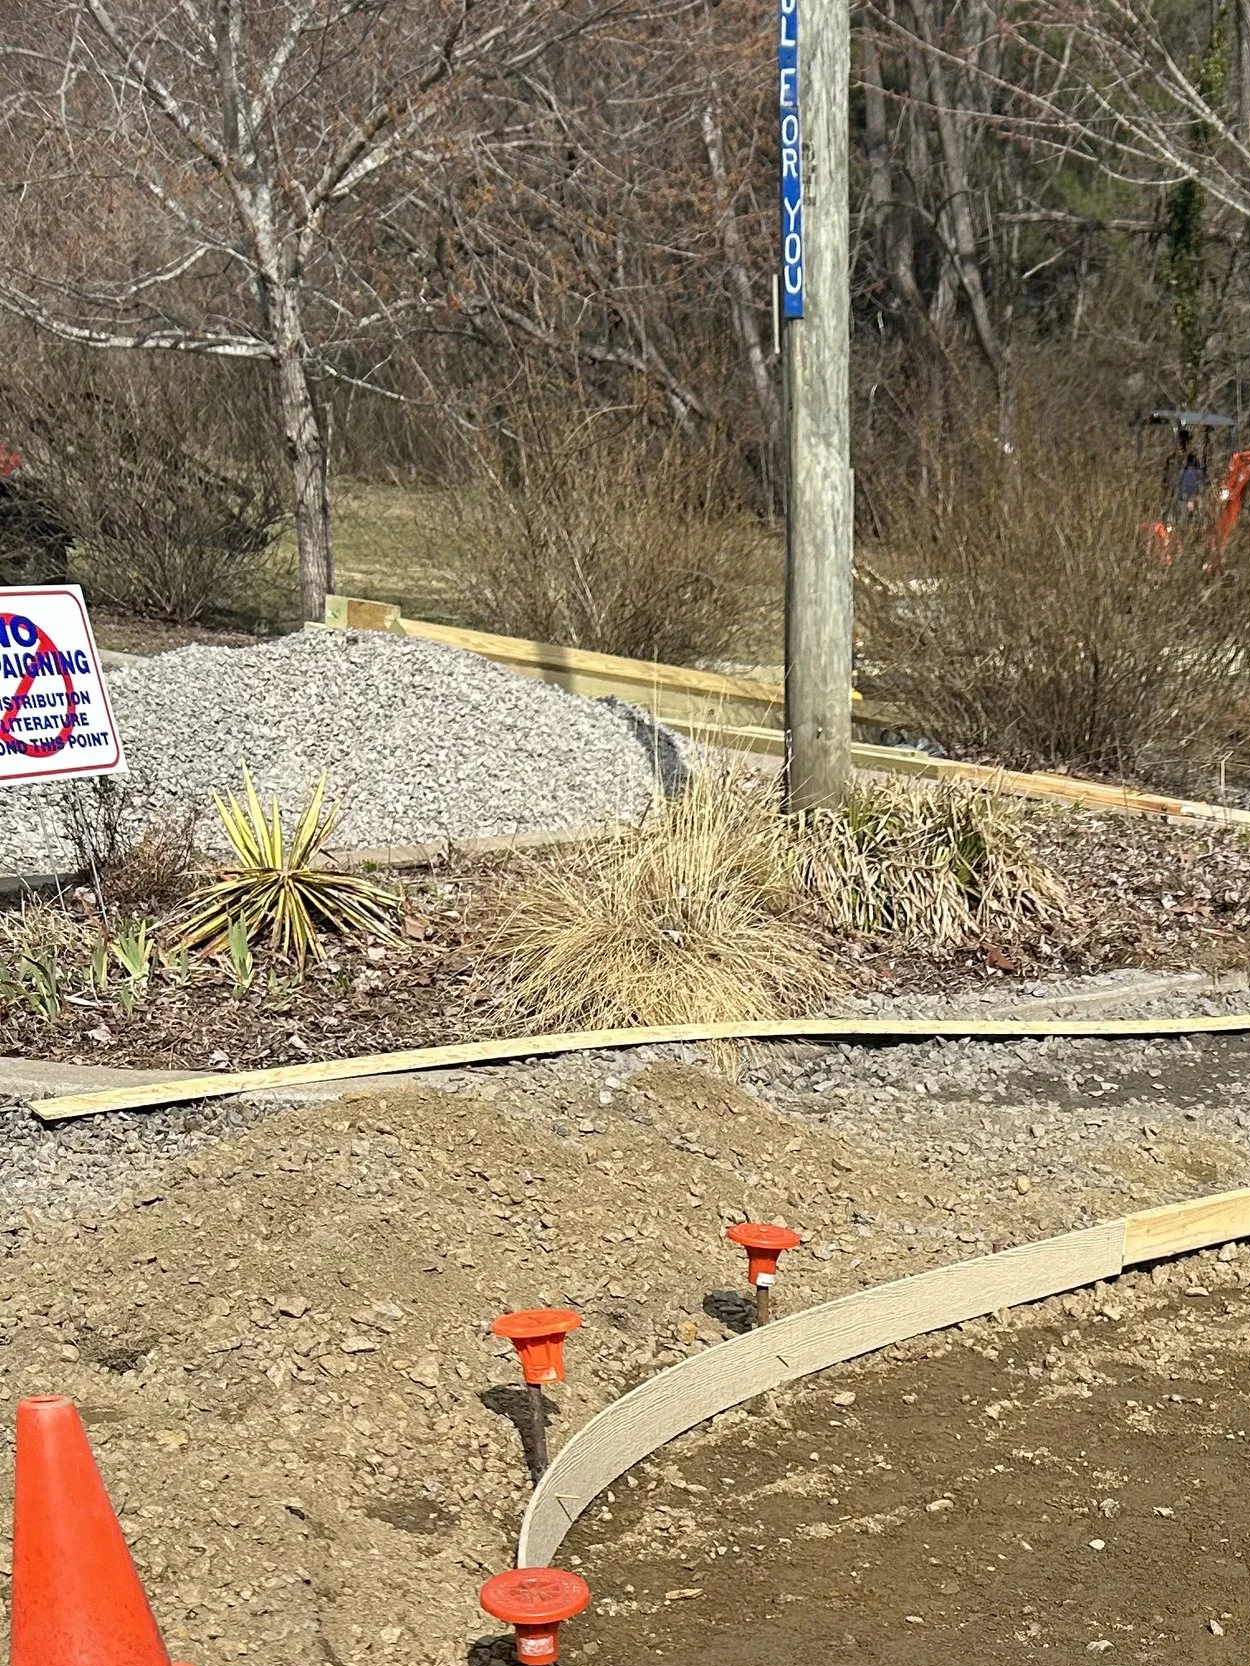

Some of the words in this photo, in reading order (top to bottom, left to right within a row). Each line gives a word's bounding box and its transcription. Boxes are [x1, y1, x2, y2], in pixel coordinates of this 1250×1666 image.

[784, 197, 802, 294] YOU
[0, 649, 91, 679] AIGNING
[29, 736, 65, 753] THIS
[67, 732, 109, 749] POINT
